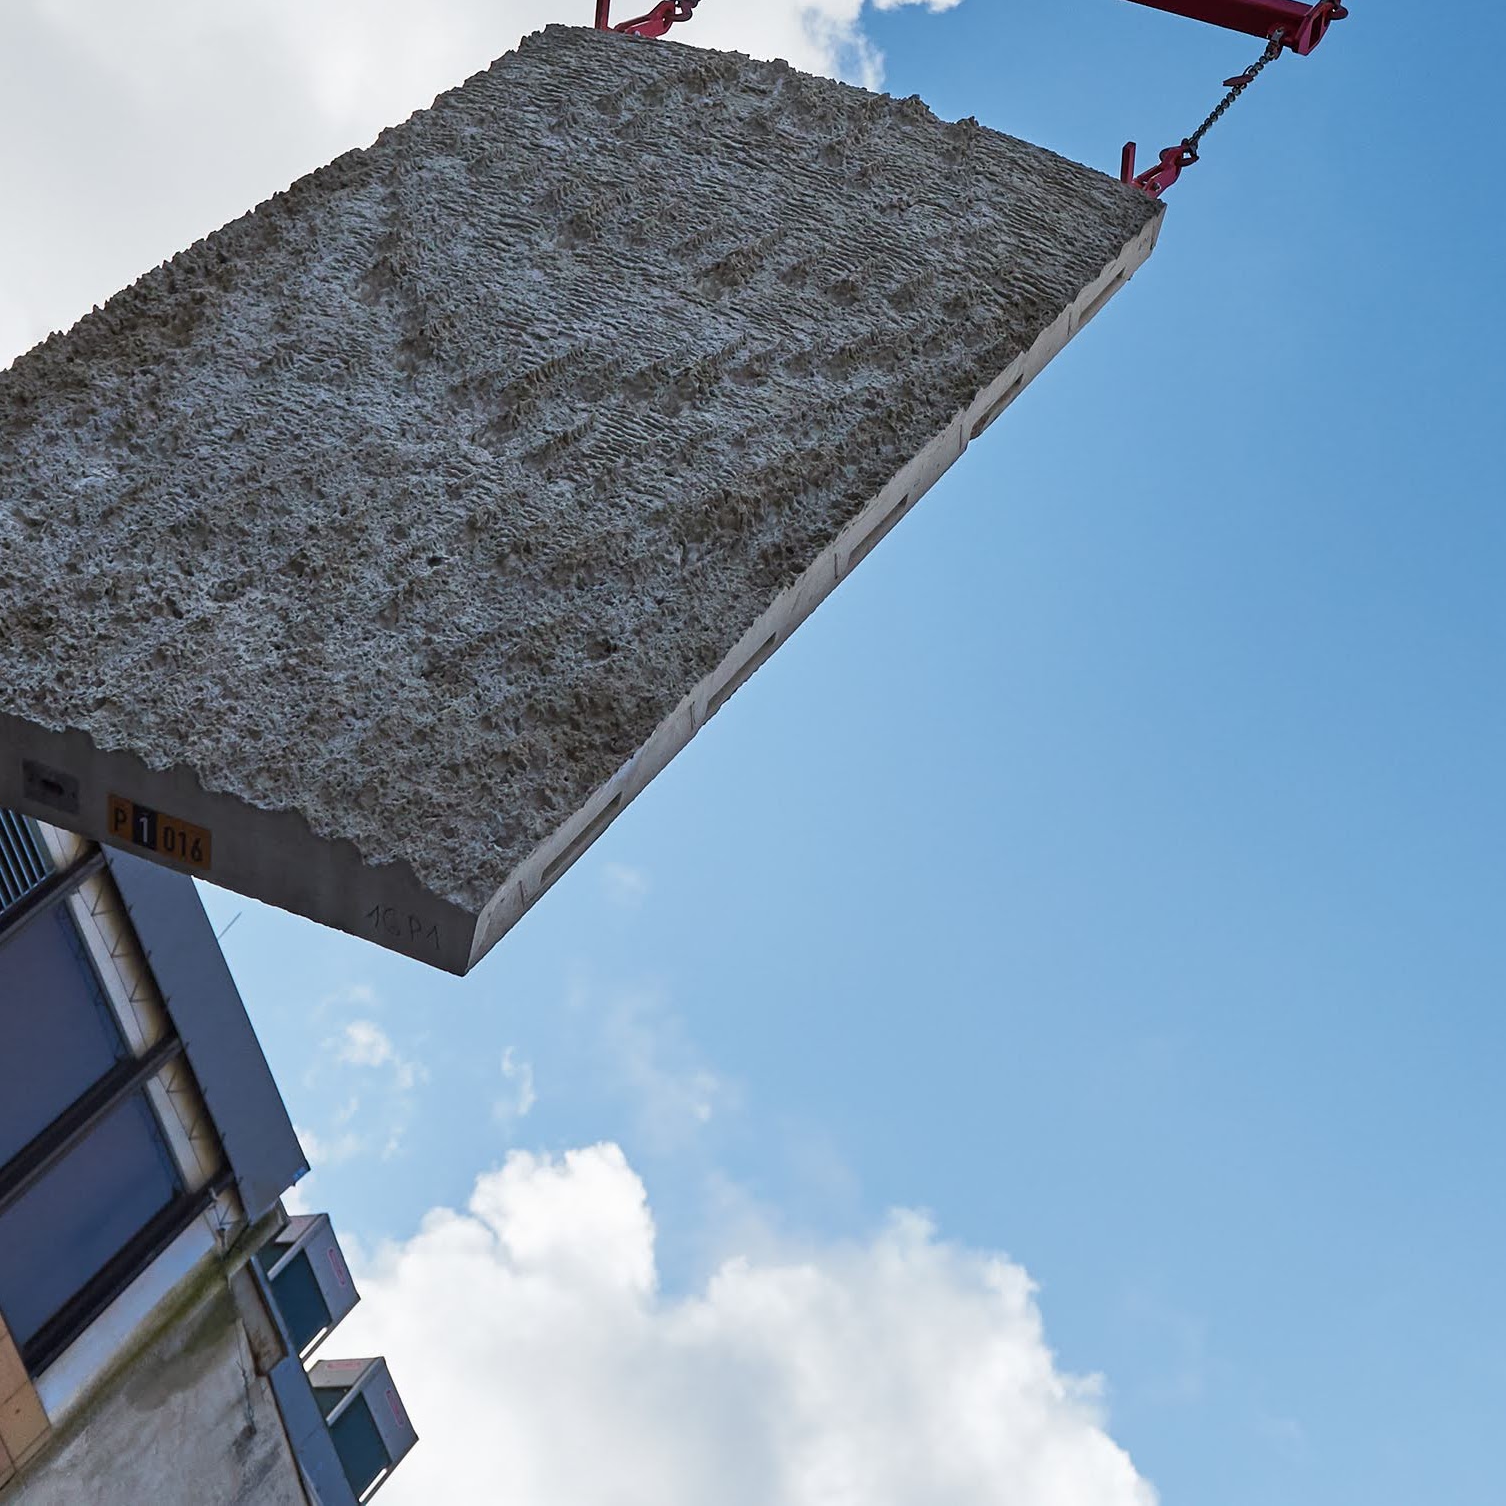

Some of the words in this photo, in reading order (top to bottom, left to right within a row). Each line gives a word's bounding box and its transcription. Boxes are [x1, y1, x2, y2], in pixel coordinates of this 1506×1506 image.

[113, 807, 127, 832] P
[139, 815, 149, 844] 1
[163, 825, 203, 862] 016
